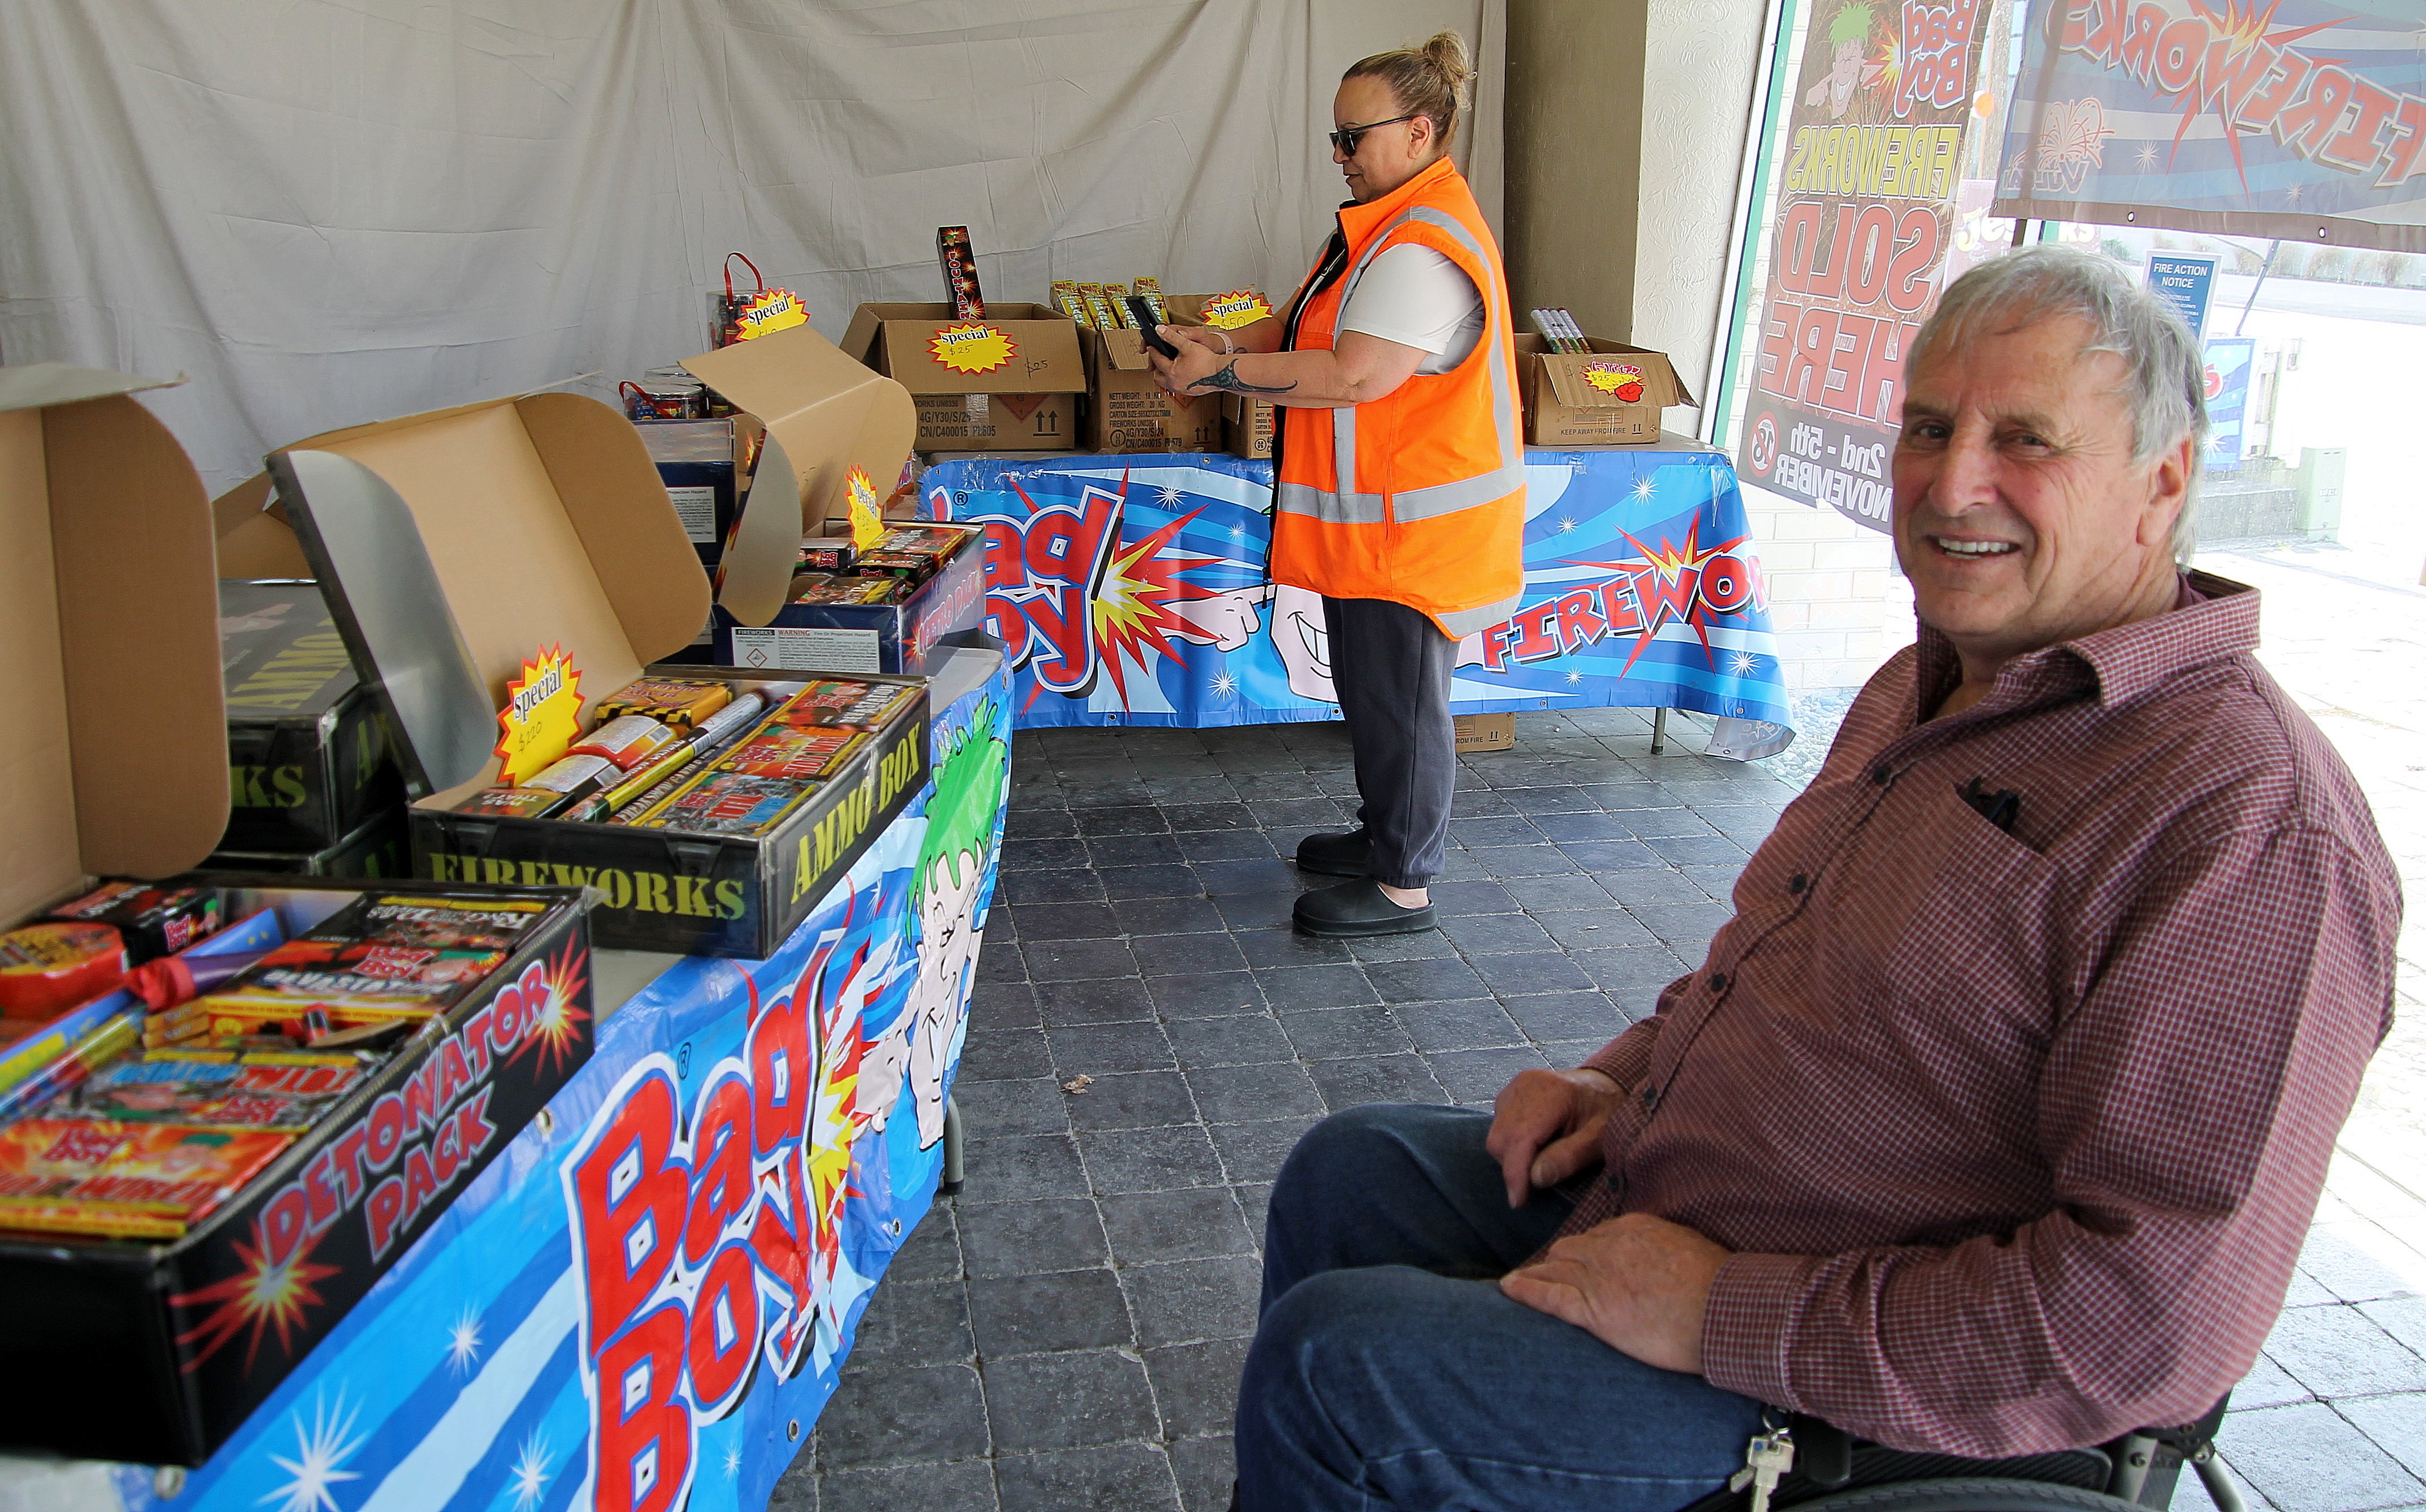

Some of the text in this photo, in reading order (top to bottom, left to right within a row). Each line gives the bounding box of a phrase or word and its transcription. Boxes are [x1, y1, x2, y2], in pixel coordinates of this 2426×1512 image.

[2153, 263, 2208, 276] FIRE ACTION
[2162, 277, 2194, 288] NOTICE
[949, 252, 971, 320] FOUNTAIN
[748, 294, 790, 325] special
[1213, 296, 1254, 317] special
[941, 327, 990, 345] special
[1221, 316, 1246, 330] $50
[949, 345, 973, 357] $25
[1024, 357, 1048, 379] $25
[920, 426, 968, 438] CN/C400015
[853, 478, 877, 520] special
[513, 657, 564, 723] special
[518, 721, 542, 755] $220
[791, 722, 921, 904] AMMO BOX
[430, 853, 744, 920] FIREWORKS
[259, 959, 553, 1278] DETONATOR
[559, 927, 842, 1360] Bad
[364, 1081, 499, 1264] PACK
